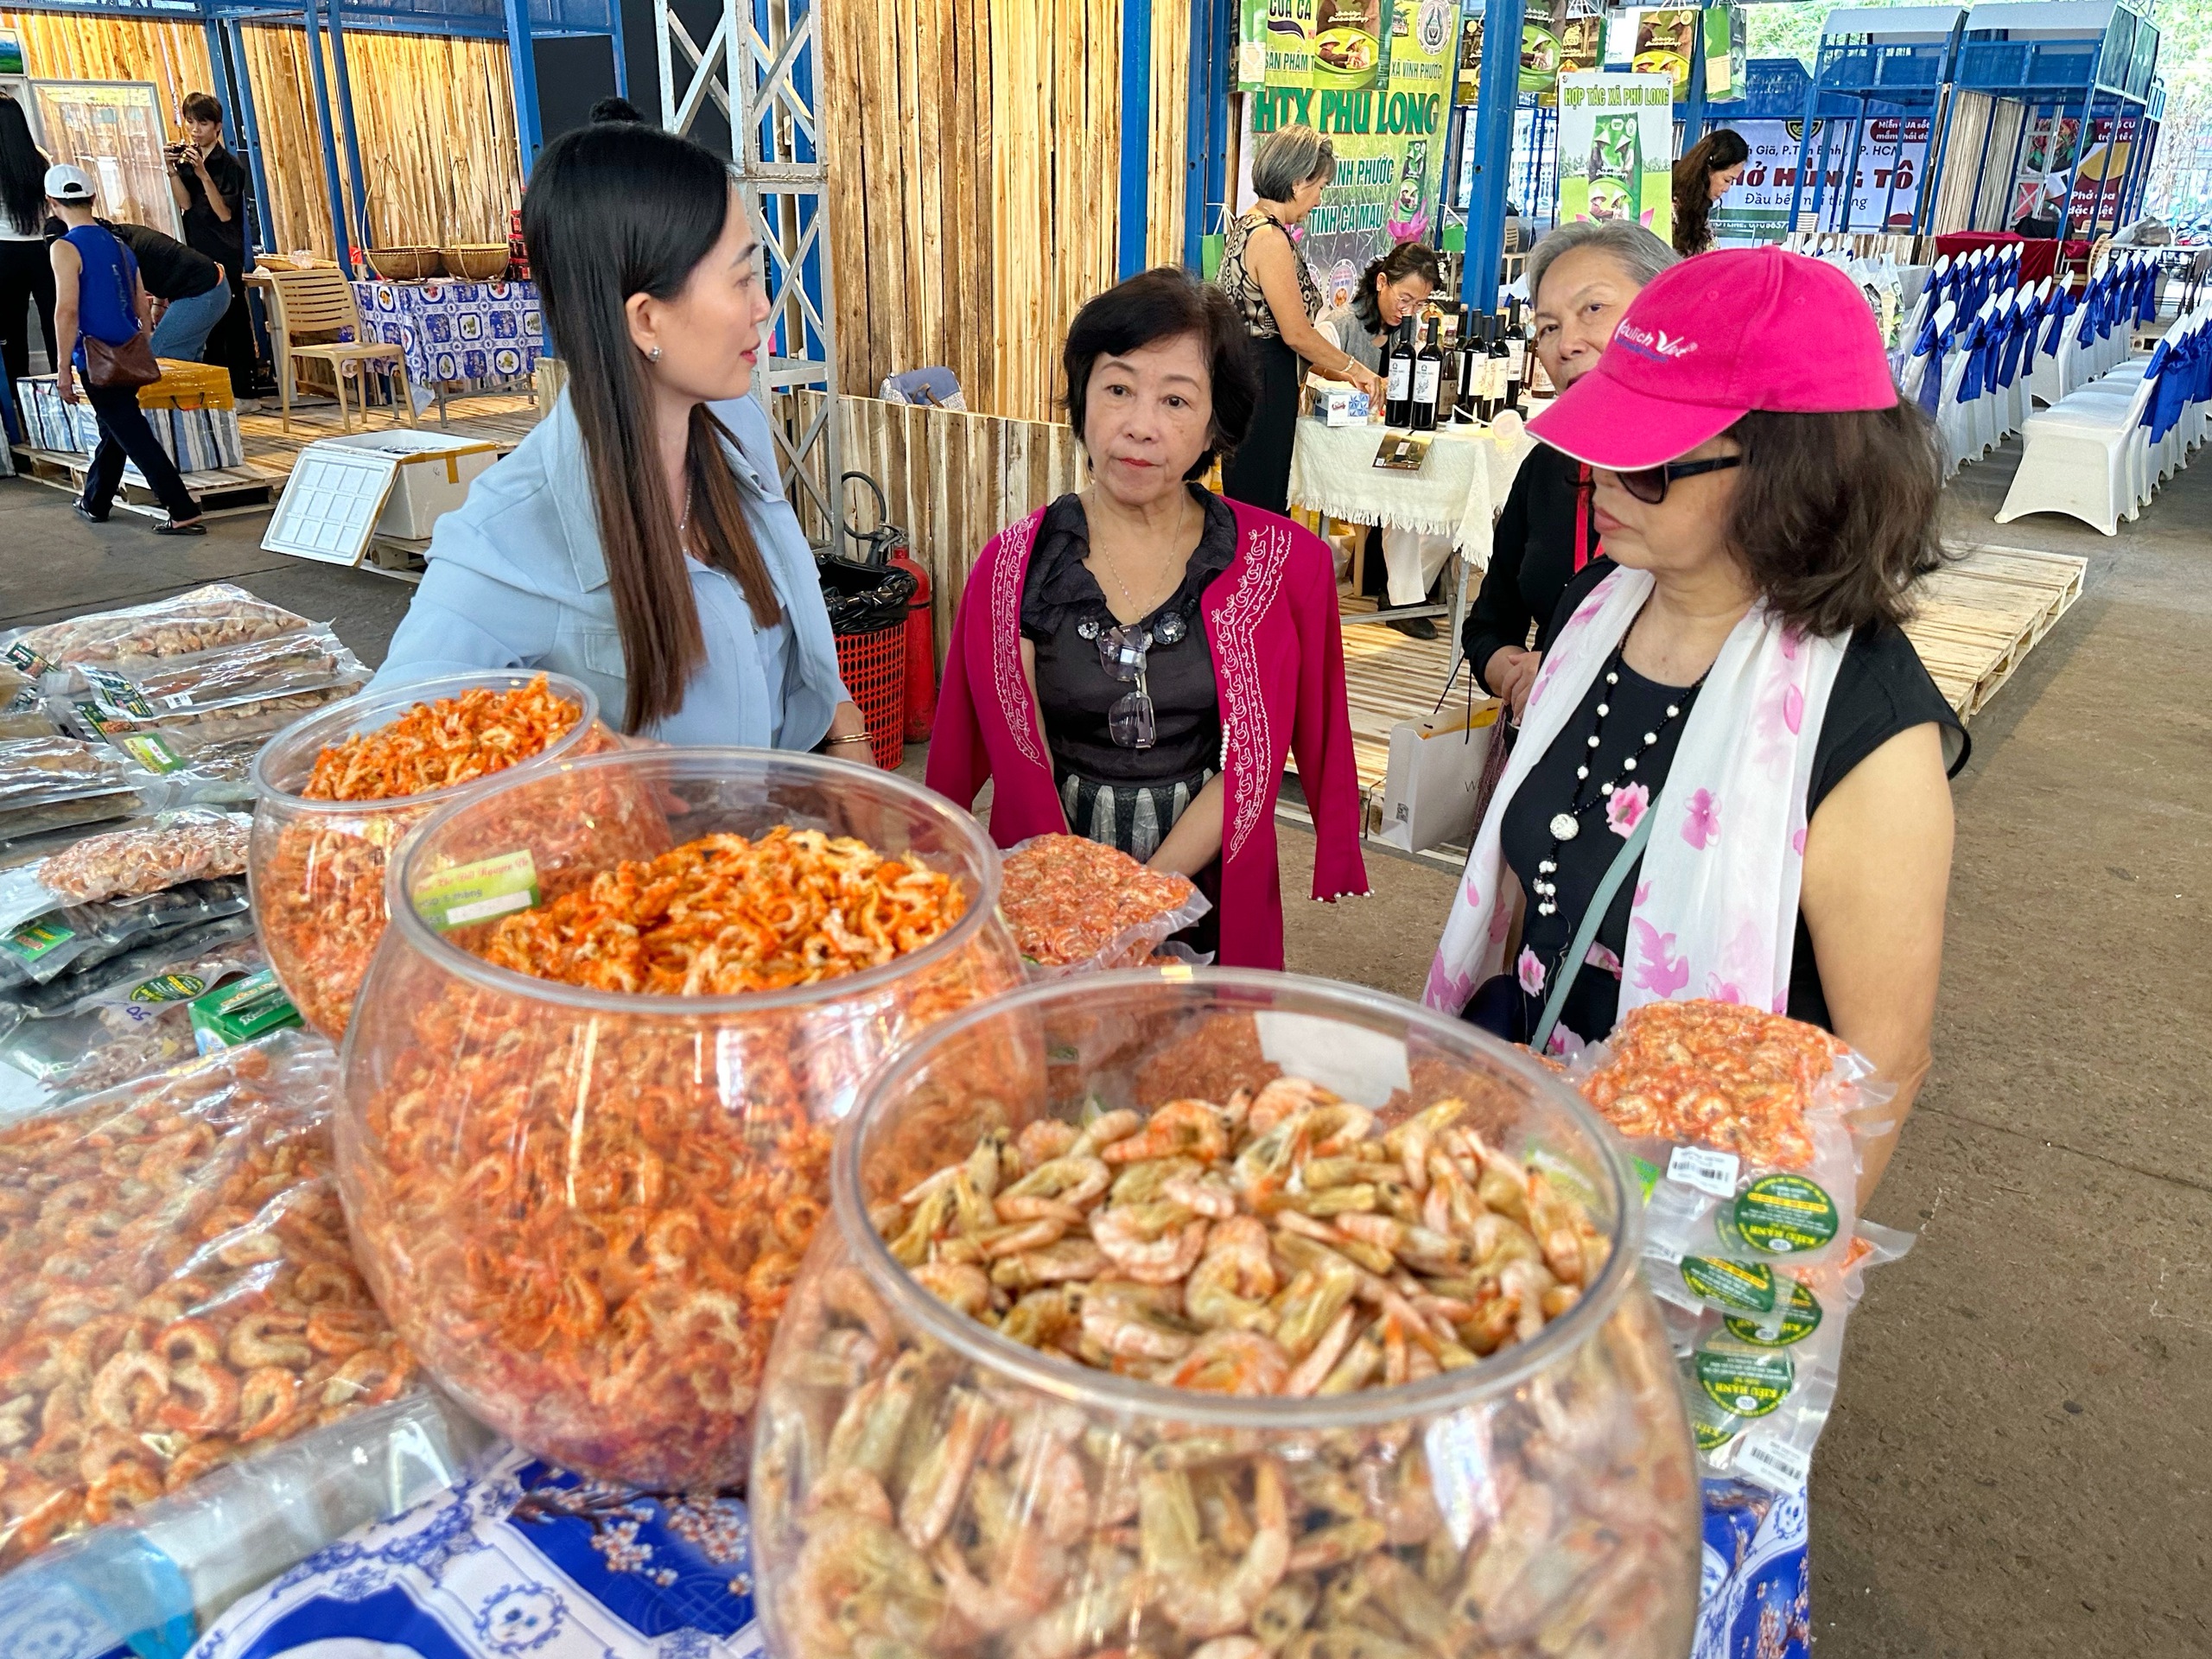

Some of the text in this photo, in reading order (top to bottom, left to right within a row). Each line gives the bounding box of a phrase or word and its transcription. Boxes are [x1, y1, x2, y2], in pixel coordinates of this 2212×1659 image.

[1255, 86, 1314, 133] HTX
[1375, 91, 1440, 135] LONG
[1564, 84, 1669, 110] HỢP TÁC XÃ PHÚ LONG
[1756, 145, 1778, 156] Giã,
[1782, 145, 1813, 156] P.Tn
[1357, 154, 1394, 186] PHƯỚC
[1745, 192, 1771, 206] Đầu
[1775, 192, 1795, 206] bế
[1803, 194, 1825, 206] ni
[1358, 203, 1384, 231] MAU
